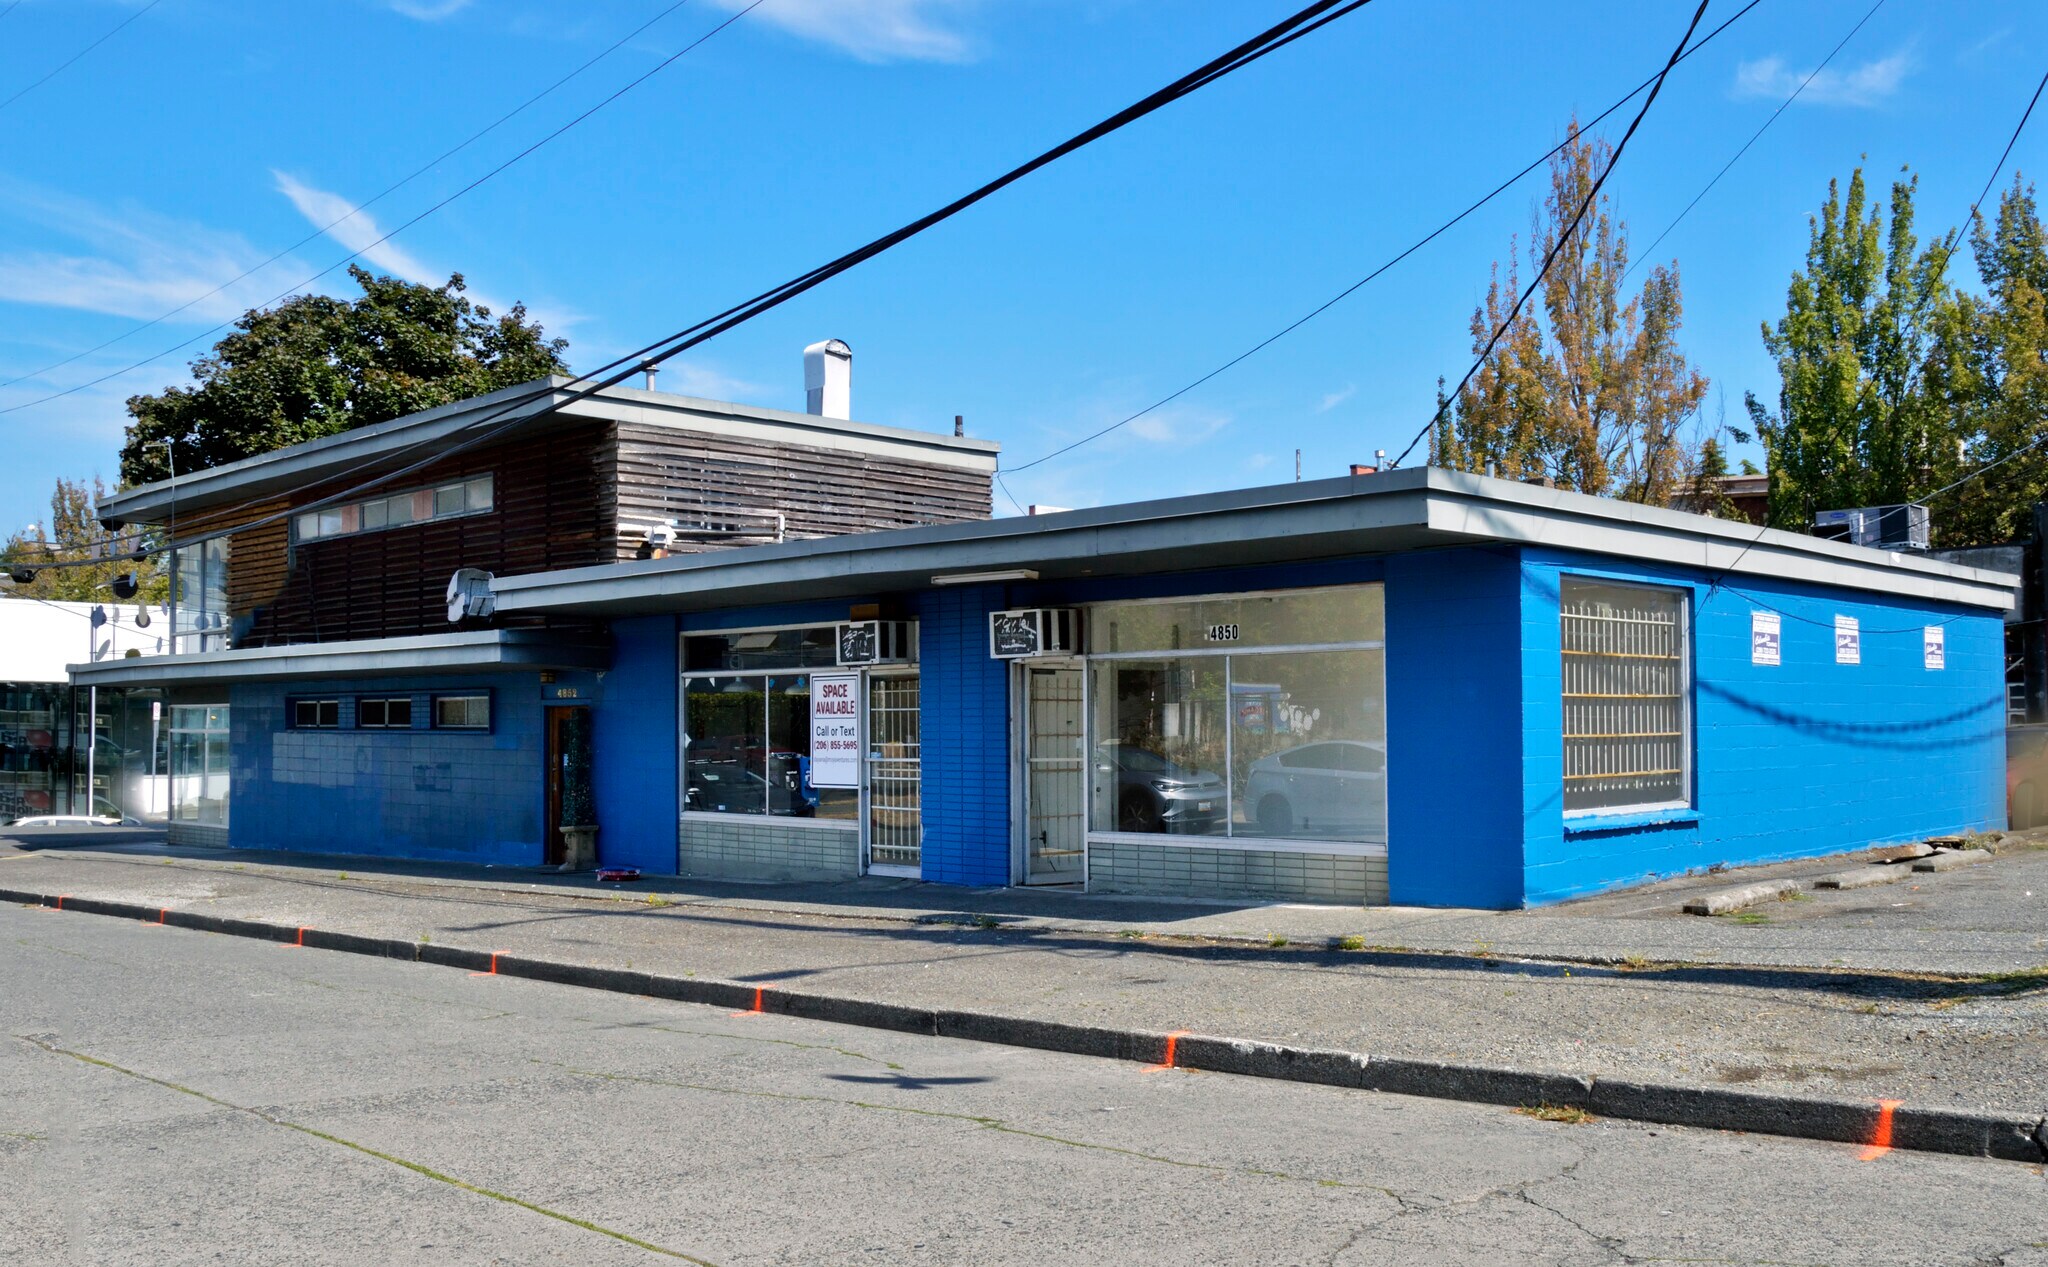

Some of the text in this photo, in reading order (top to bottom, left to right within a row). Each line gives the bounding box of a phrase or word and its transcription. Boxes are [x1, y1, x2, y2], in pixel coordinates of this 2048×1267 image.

[1211, 624, 1238, 640] 4850
[823, 684, 847, 698] SPACE
[816, 701, 855, 714] AVAILABLE
[816, 726, 829, 736] Call
[840, 726, 855, 736] Text
[814, 741, 857, 752] (206) 855-5695
